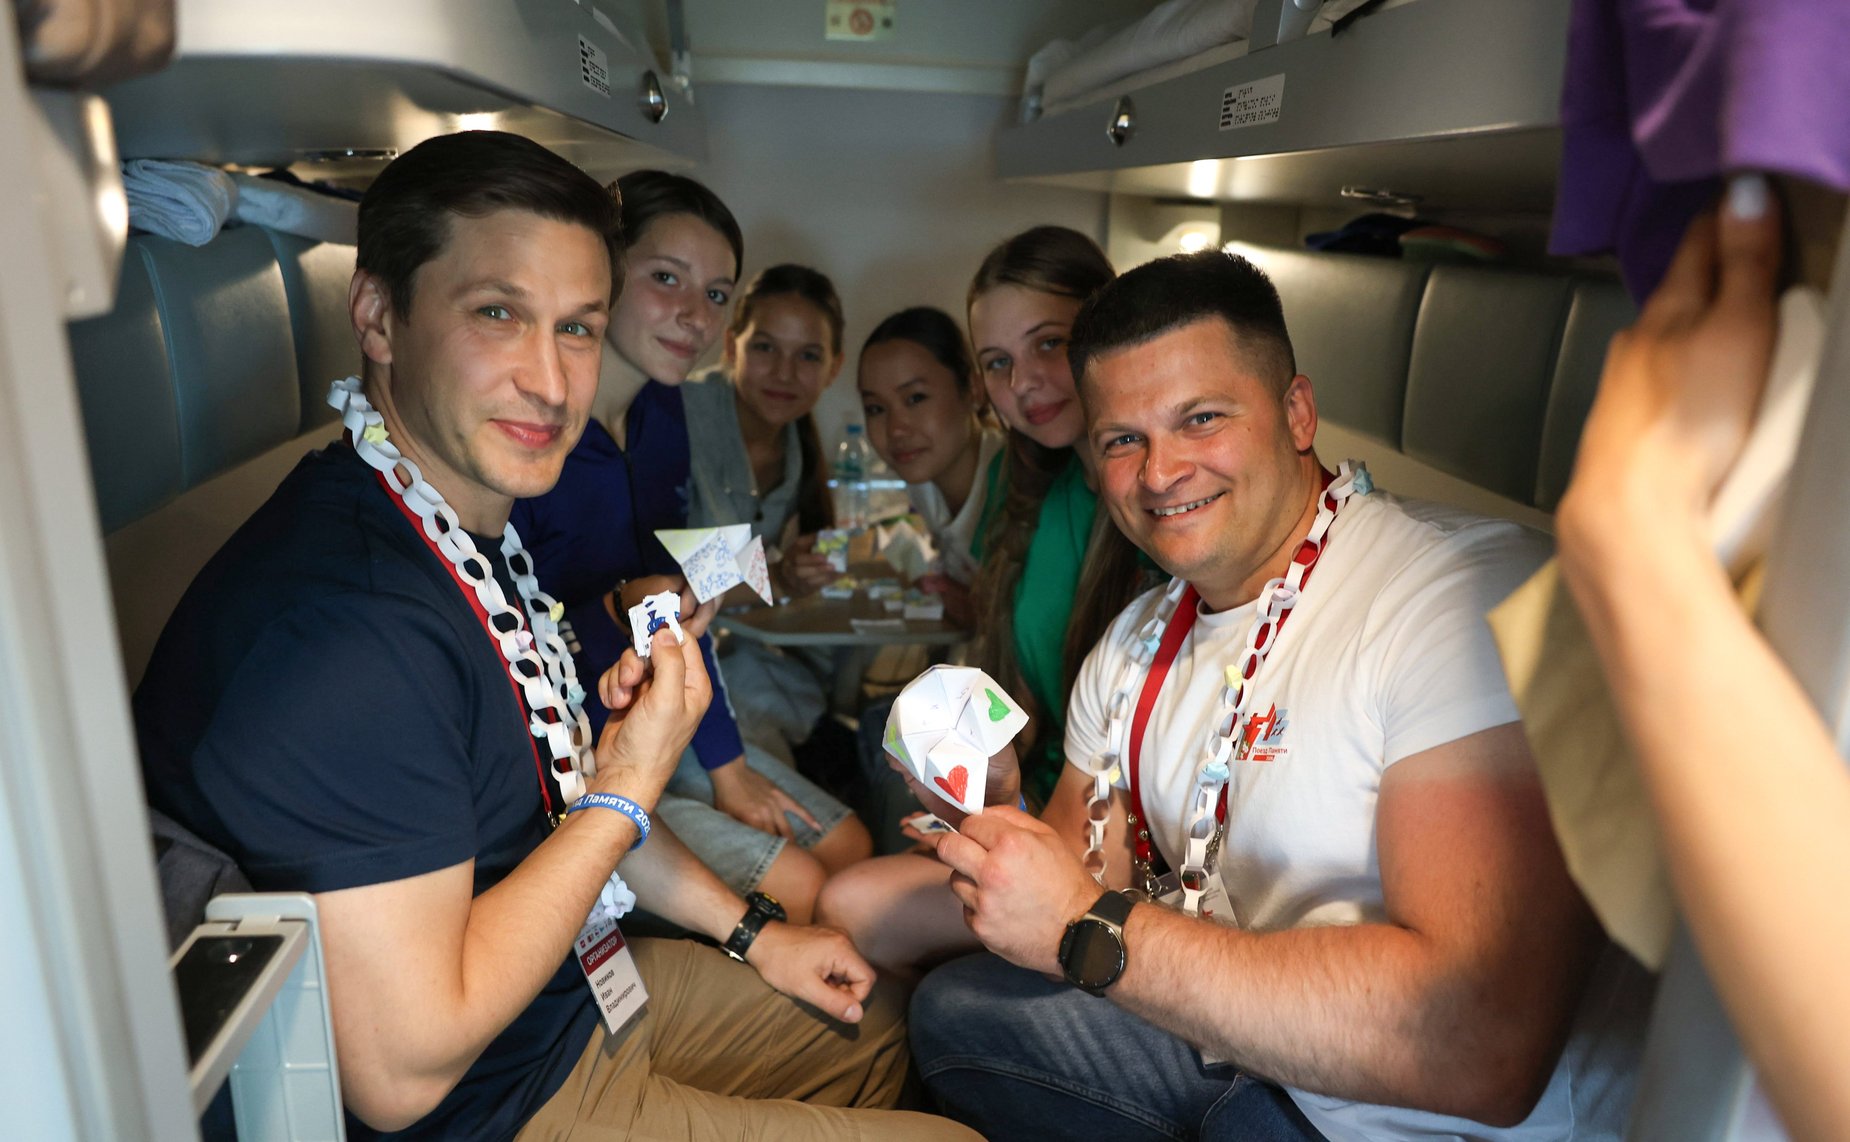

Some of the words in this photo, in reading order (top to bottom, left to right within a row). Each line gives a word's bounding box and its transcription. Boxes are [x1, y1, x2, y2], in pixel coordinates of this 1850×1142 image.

[584, 794, 635, 814] Памяти
[586, 936, 618, 966] ОРГАНИЗАТОР
[595, 969, 615, 989] Новиков
[601, 987, 613, 1001] Иван
[605, 982, 637, 1014] Владимирович
